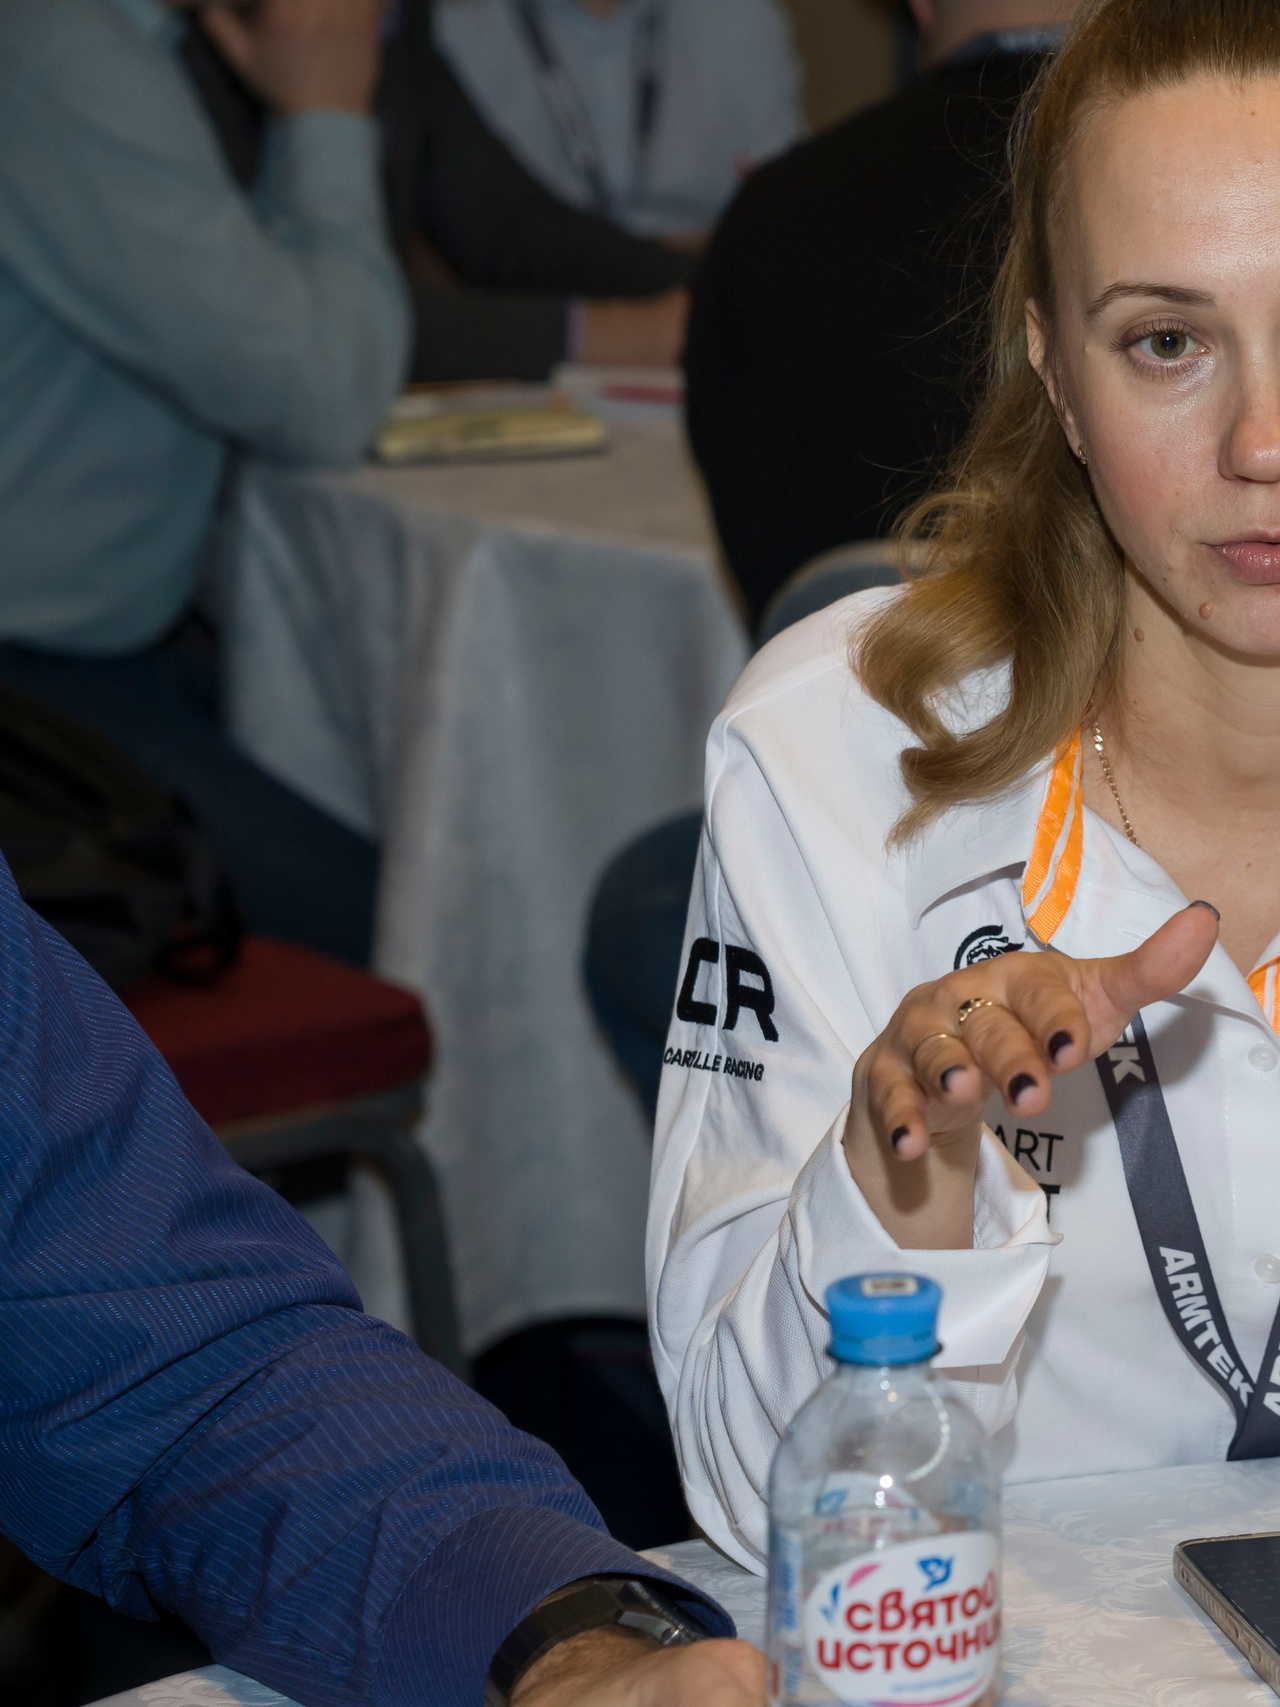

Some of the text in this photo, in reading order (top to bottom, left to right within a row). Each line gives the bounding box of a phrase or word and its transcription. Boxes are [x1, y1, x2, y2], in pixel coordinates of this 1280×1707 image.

[676, 937, 779, 1042] CR
[723, 1057, 764, 1081] RACING
[1159, 1246, 1254, 1408] ARMTEK
